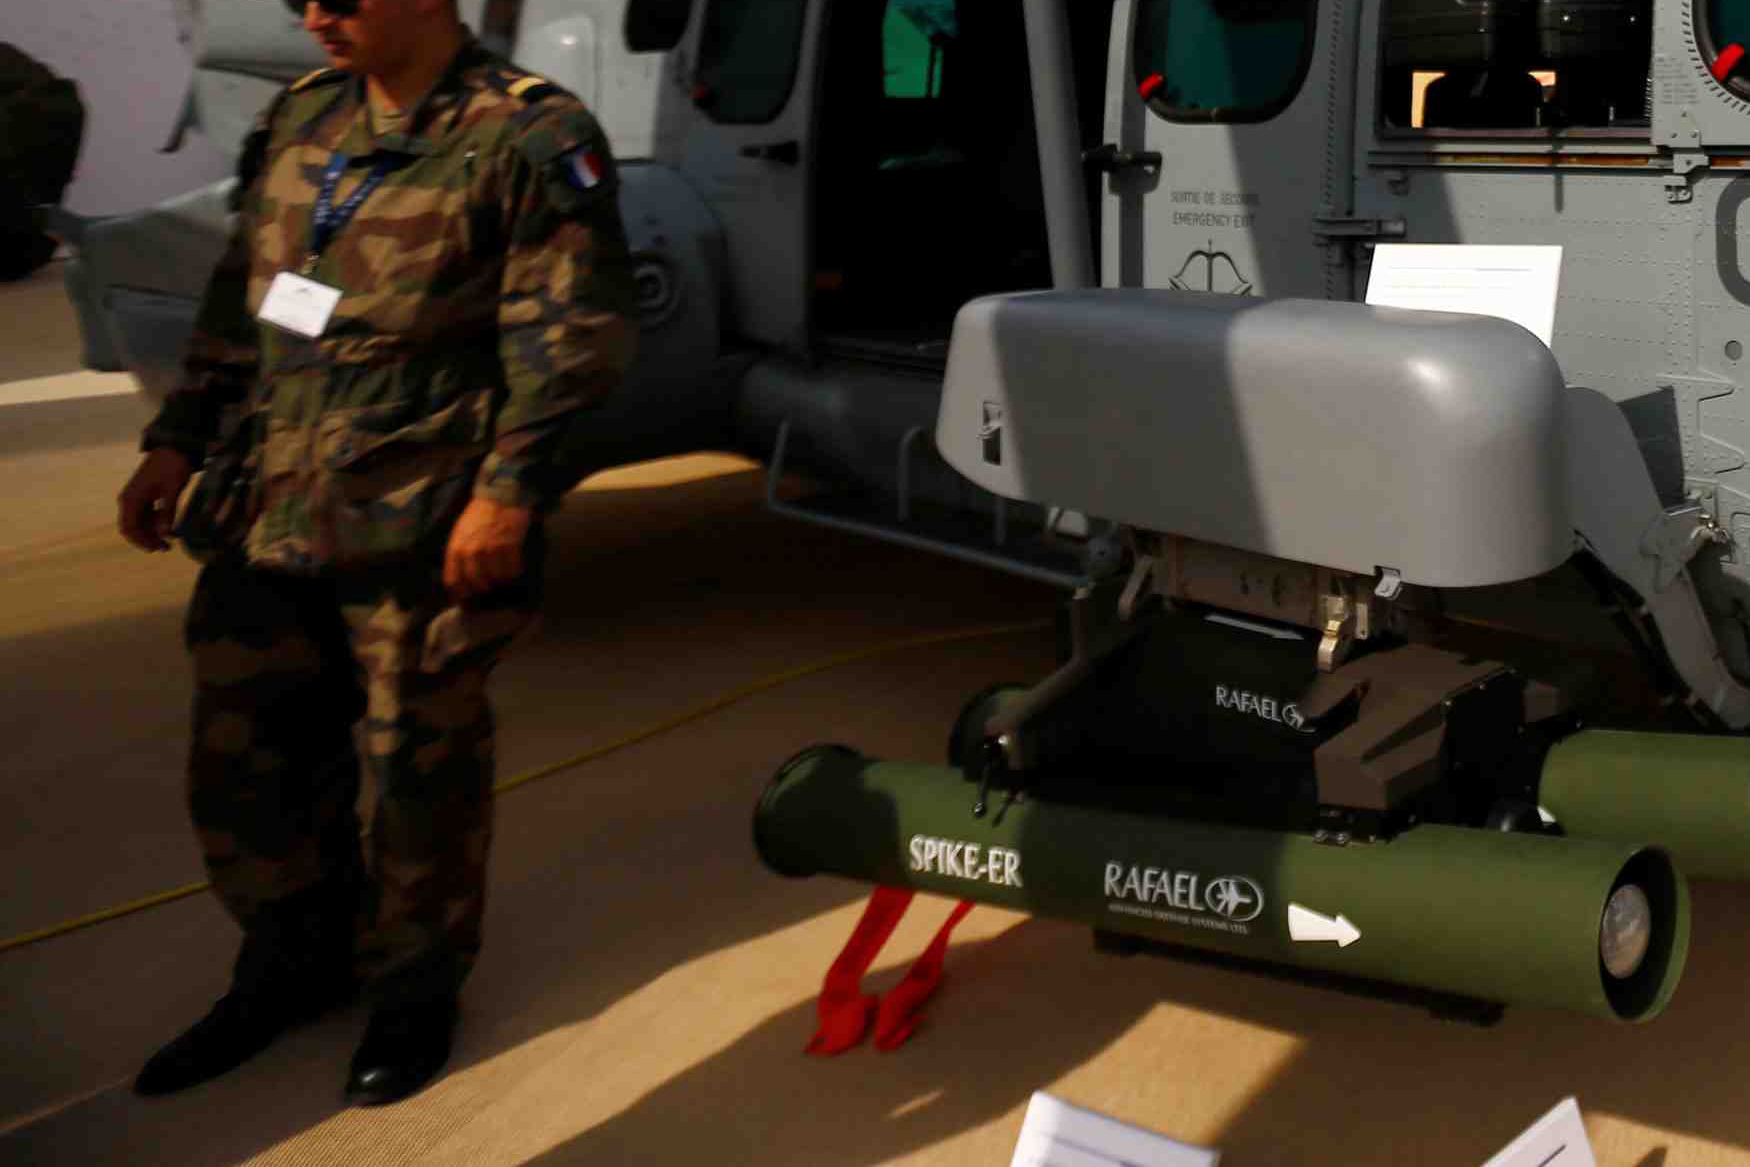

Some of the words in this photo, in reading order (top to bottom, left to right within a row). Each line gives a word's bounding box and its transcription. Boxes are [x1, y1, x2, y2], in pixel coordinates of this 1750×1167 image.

[1215, 685, 1283, 723] RAFAEL
[909, 833, 1023, 888] SPIKE-ER
[1103, 860, 1206, 912] RAFAEL
